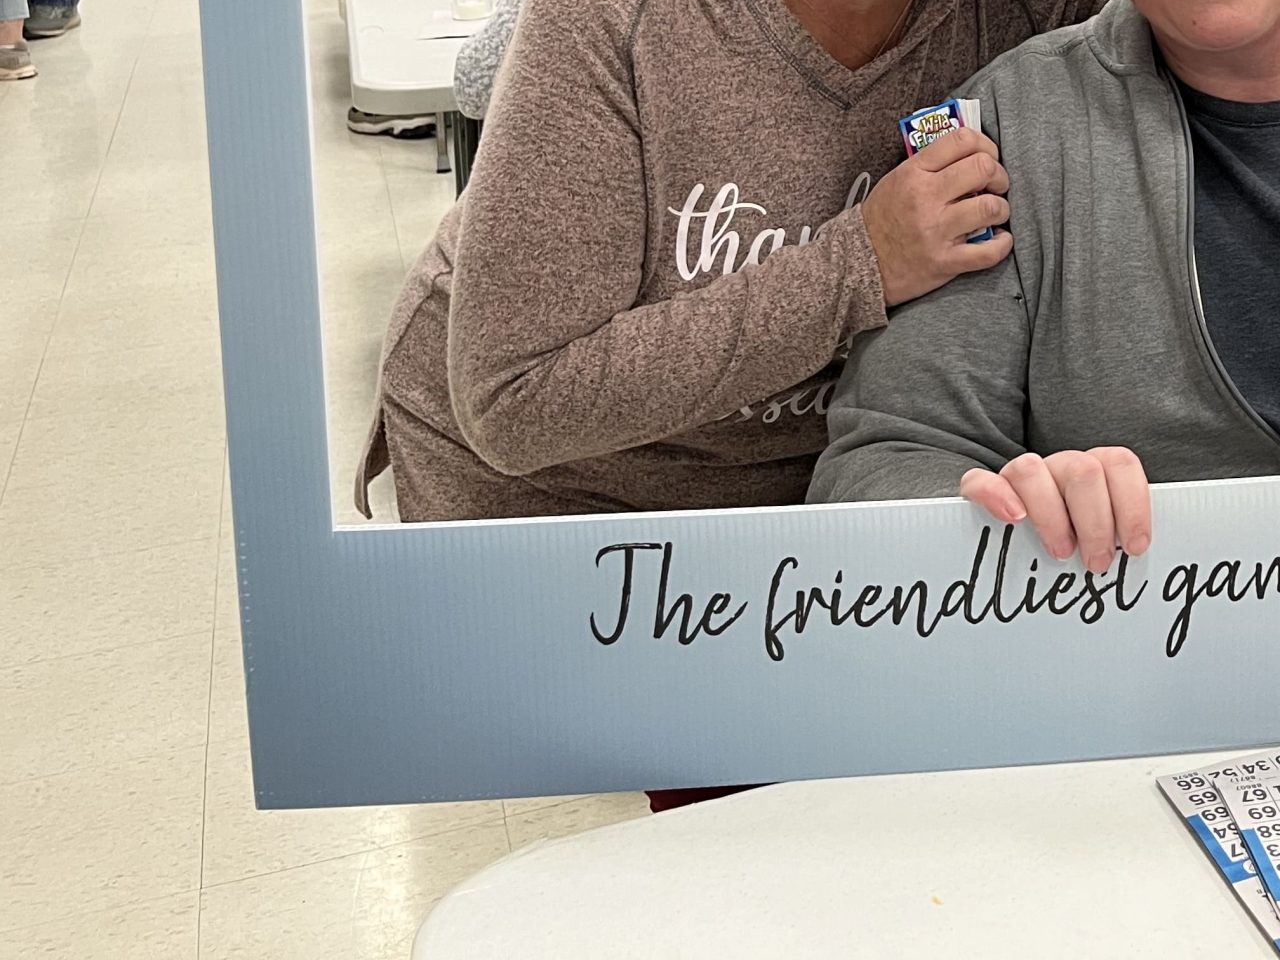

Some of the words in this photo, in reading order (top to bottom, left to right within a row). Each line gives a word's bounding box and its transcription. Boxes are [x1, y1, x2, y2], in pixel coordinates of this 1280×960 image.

[922, 113, 951, 133] Wild
[589, 541, 747, 647] The
[763, 522, 1154, 661] friendliest
[1243, 760, 1271, 775] 34
[1242, 788, 1268, 803] 67
[1248, 805, 1277, 820] 69
